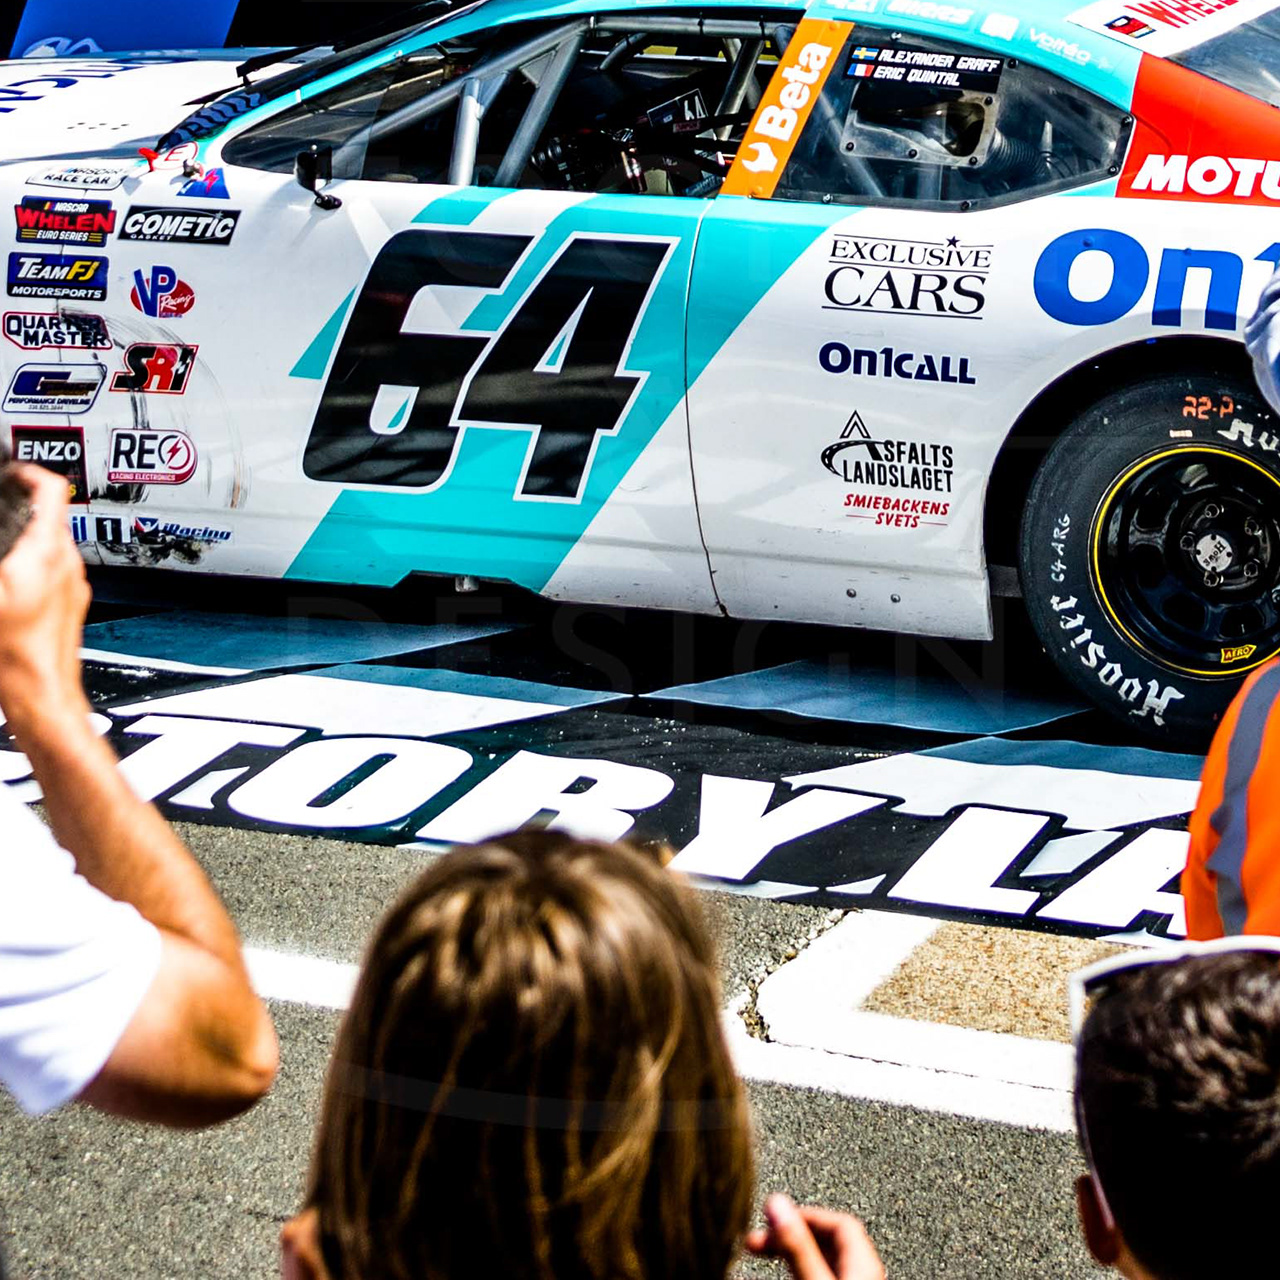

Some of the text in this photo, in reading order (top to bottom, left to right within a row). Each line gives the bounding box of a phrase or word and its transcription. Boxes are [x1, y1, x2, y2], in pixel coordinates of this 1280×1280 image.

[879, 49, 1001, 73] ALEXANDER GRAFF
[873, 65, 960, 87] ERIC QUINTAL
[761, 43, 832, 140] Beta
[44, 174, 111, 185] RACE CAR
[55, 202, 89, 213] NASCAR
[15, 205, 117, 234] WHELEN
[124, 213, 235, 238] COMETIC
[37, 229, 89, 242] EURO SERIES
[830, 236, 992, 269] EXCLUSIVE
[11, 286, 102, 299] MOTORSPORTS
[133, 265, 177, 318] VP
[823, 265, 986, 316] CARS
[23, 331, 106, 346] MASTER
[303, 229, 679, 503] 64
[18, 440, 82, 462] ENZO
[842, 458, 954, 492] LANDSLAGET
[844, 493, 950, 516] SMIEBACKENS
[875, 511, 921, 528] SVETS
[1226, 646, 1251, 661] AERO
